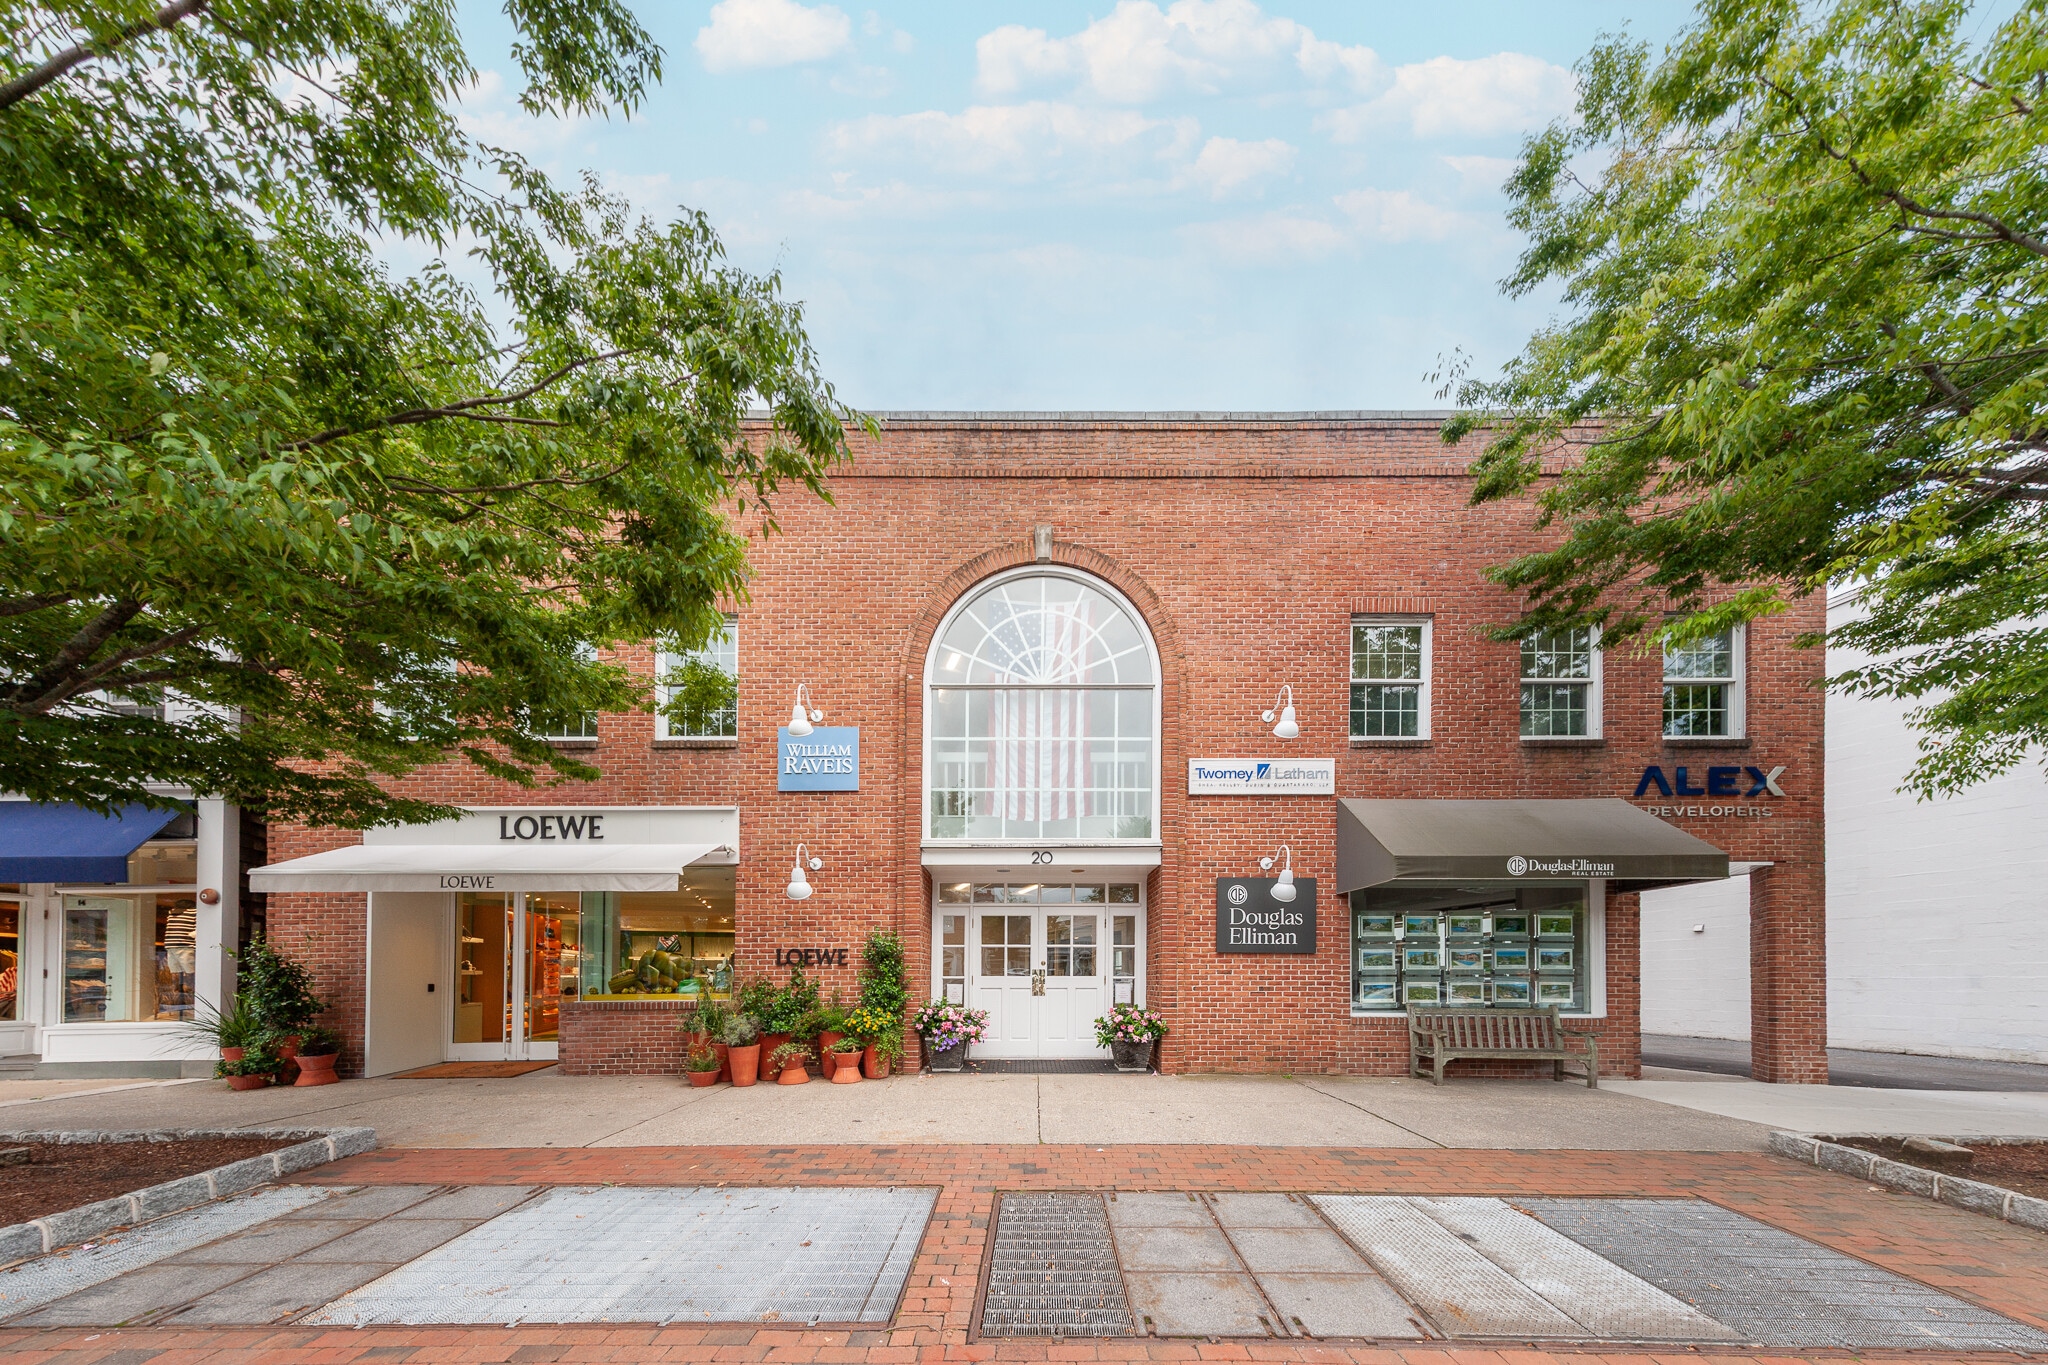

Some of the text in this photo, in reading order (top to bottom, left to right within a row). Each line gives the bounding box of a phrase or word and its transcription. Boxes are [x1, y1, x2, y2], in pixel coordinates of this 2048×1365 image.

[785, 743, 852, 757] WILLIAM
[784, 756, 853, 774] RAVEIS
[1195, 767, 1329, 782] Twomey Latham
[1634, 765, 1787, 797] ALEX
[1647, 806, 1773, 817] DEVELOPERS
[499, 815, 604, 840] LOEWE
[1031, 851, 1053, 865] 20
[440, 875, 495, 889] LOEWE
[1229, 907, 1304, 930] Douglas
[1229, 927, 1298, 945] Elliman
[776, 948, 849, 966] LOEWE
